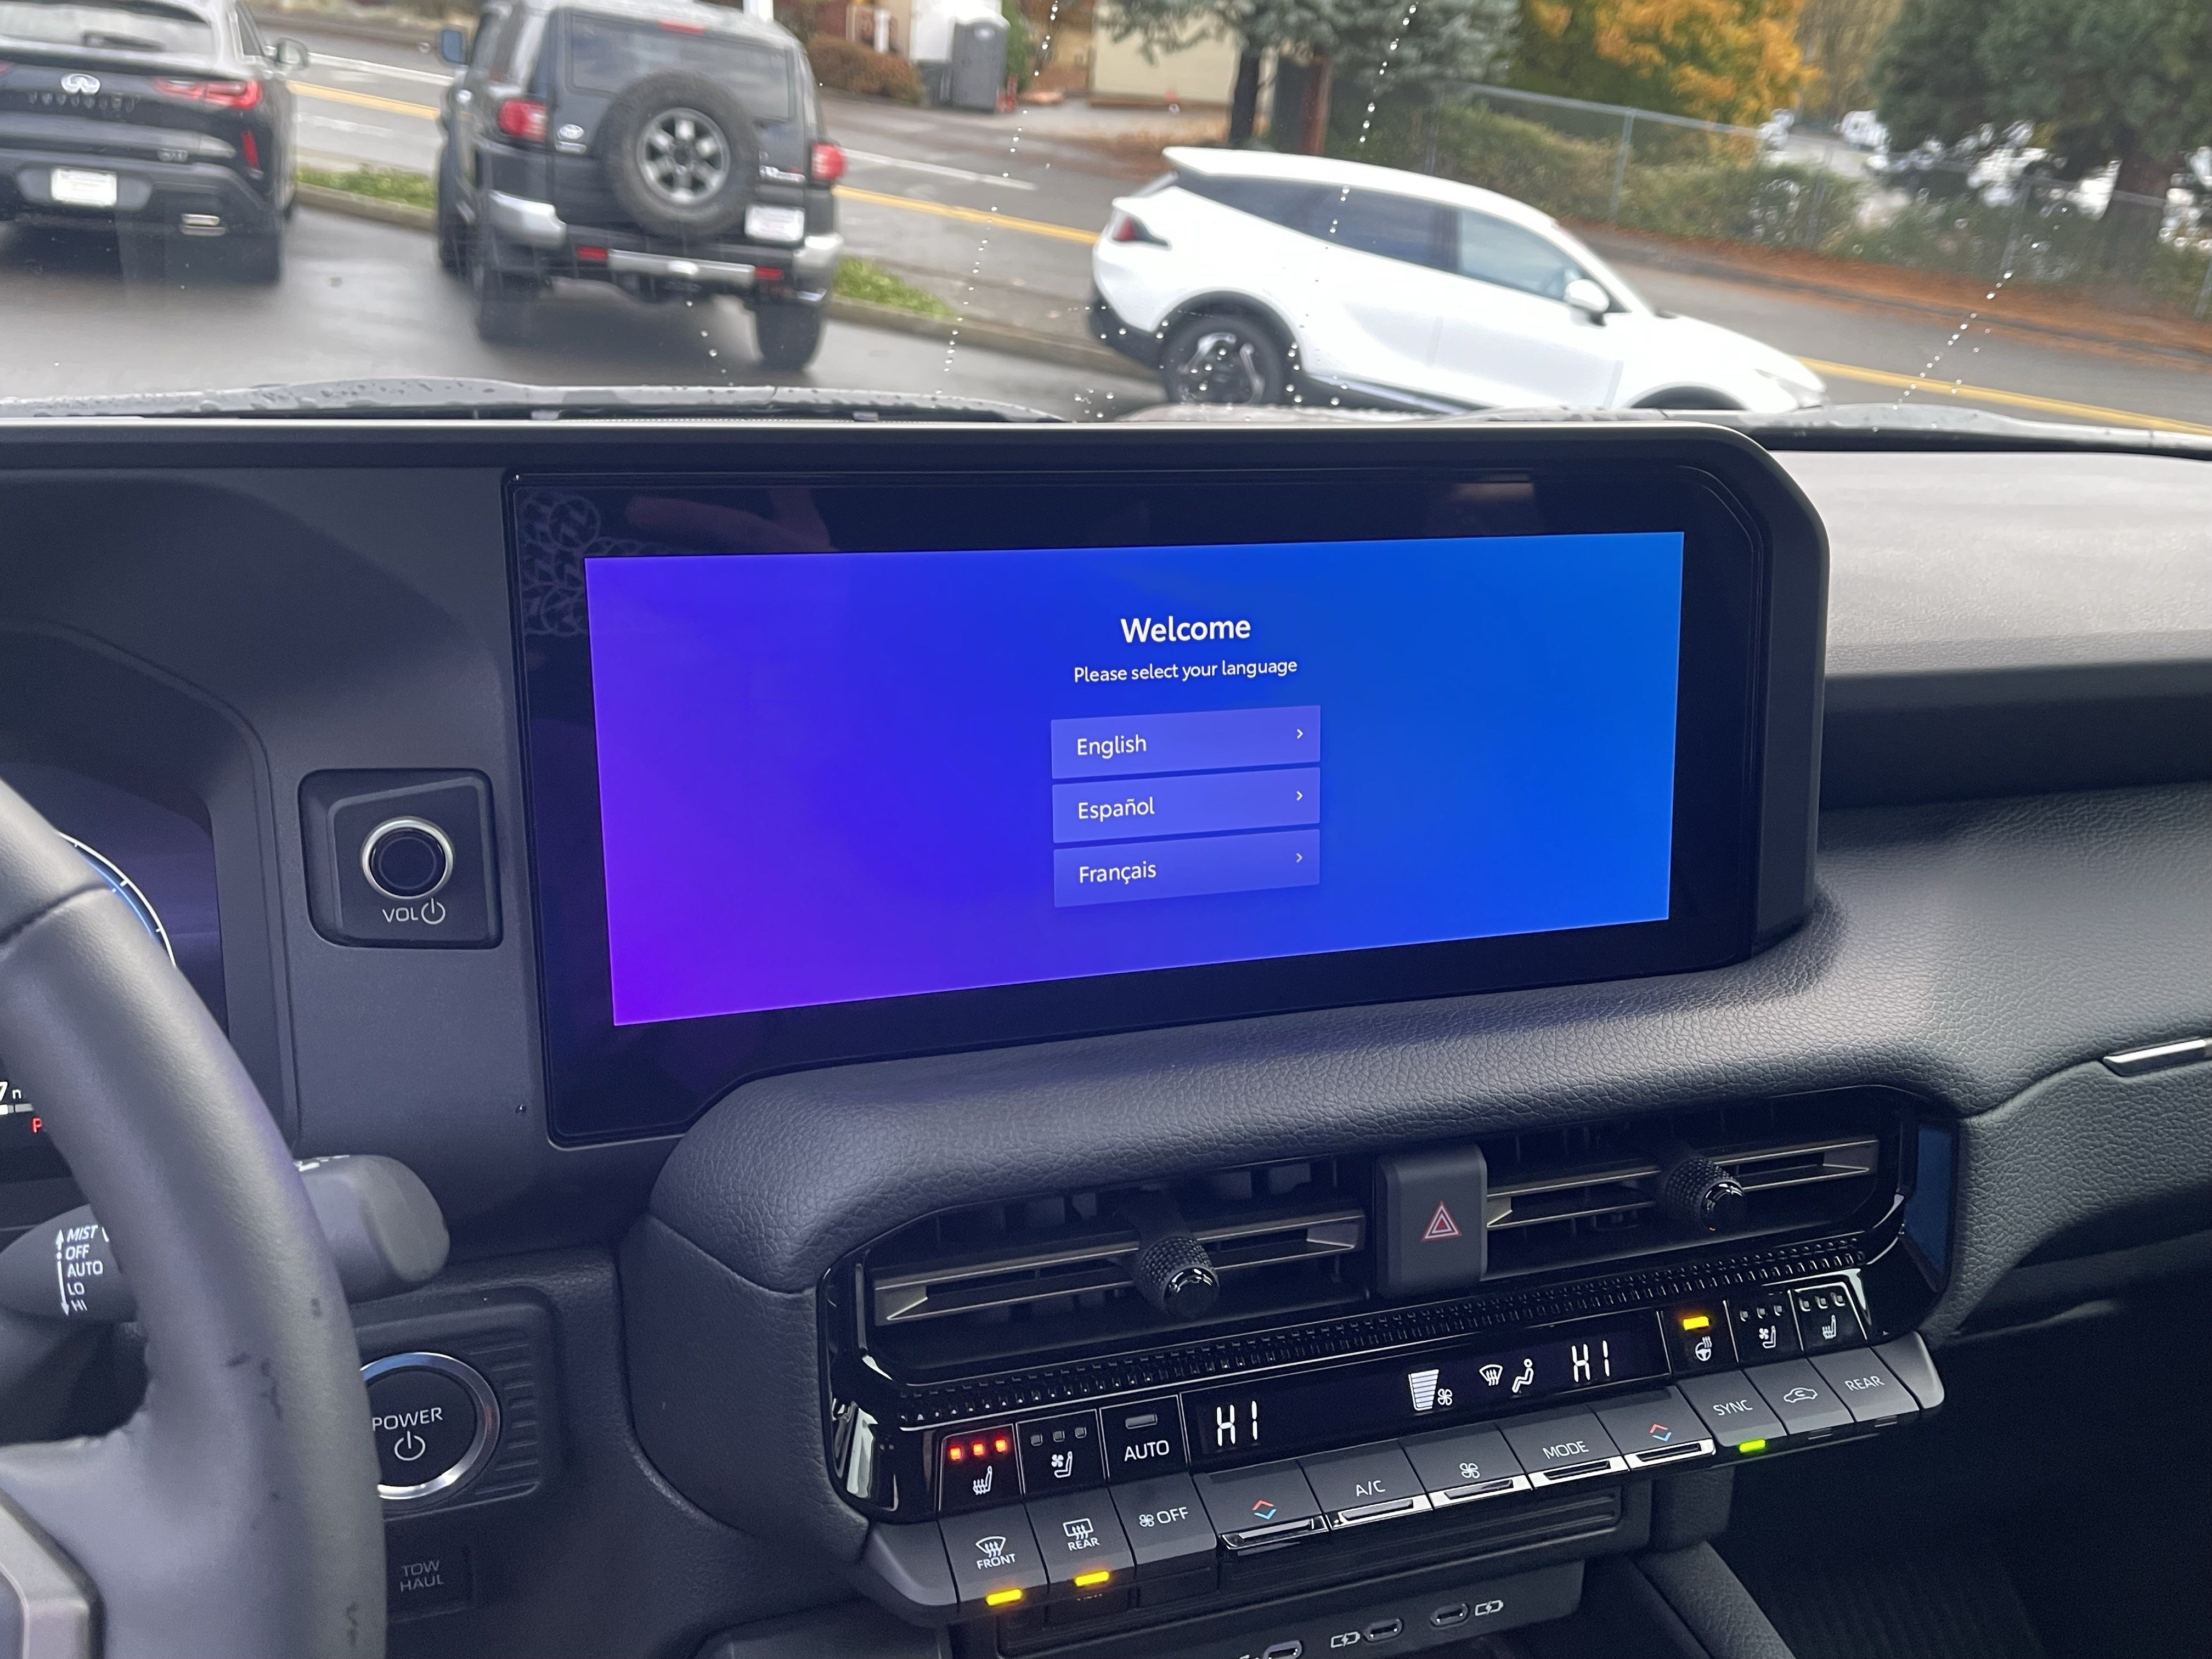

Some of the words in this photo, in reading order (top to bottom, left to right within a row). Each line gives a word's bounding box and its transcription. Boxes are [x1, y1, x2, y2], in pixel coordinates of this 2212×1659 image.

[1120, 616, 1251, 643] Welcome
[1074, 666, 1127, 683] Please
[1131, 663, 1179, 680] select
[1182, 665, 1218, 682] your
[1222, 660, 1297, 679] language
[1077, 734, 1147, 759] English
[1078, 796, 1155, 822] Español
[1079, 860, 1156, 884] Français
[382, 907, 419, 923] VOL
[32, 1118, 42, 1133] P
[66, 1224, 98, 1243] MIST
[65, 1244, 90, 1261] OFF
[66, 1260, 103, 1278] AUTO
[67, 1282, 85, 1296] LO
[71, 1299, 87, 1312] HI
[1844, 1375, 1885, 1391] REAR
[1713, 1400, 1753, 1416] SYNC
[372, 1407, 443, 1431] POWER
[1124, 1440, 1170, 1462] AUTO
[1542, 1441, 1589, 1459] MODE
[1356, 1480, 1386, 1497] A/C
[1156, 1506, 1188, 1523] OFF
[1067, 1537, 1100, 1551] REAR
[402, 1560, 440, 1577] TOW
[976, 1553, 1015, 1570] FRONT
[400, 1575, 444, 1592] HAUL
